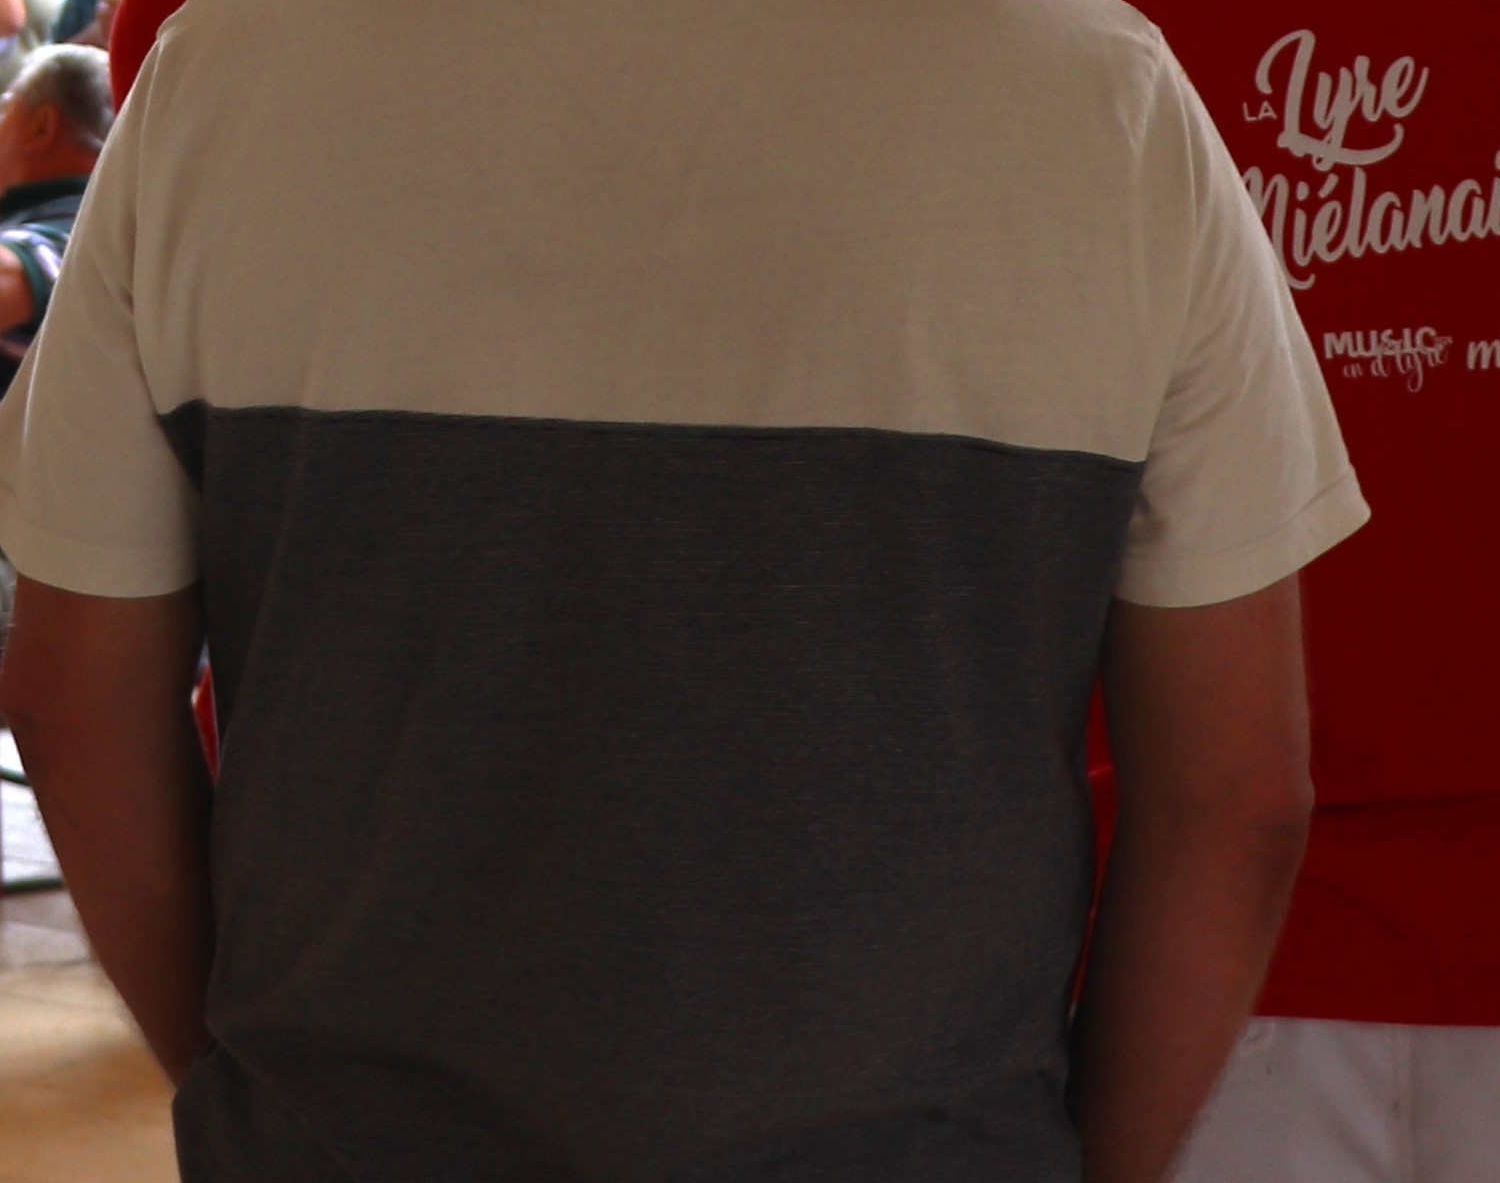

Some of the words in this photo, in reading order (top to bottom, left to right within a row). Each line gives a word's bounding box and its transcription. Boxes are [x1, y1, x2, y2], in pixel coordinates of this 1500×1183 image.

[1242, 100, 1278, 122] LA
[1254, 28, 1429, 172] Lyre
[1322, 325, 1439, 359] MUSIC
